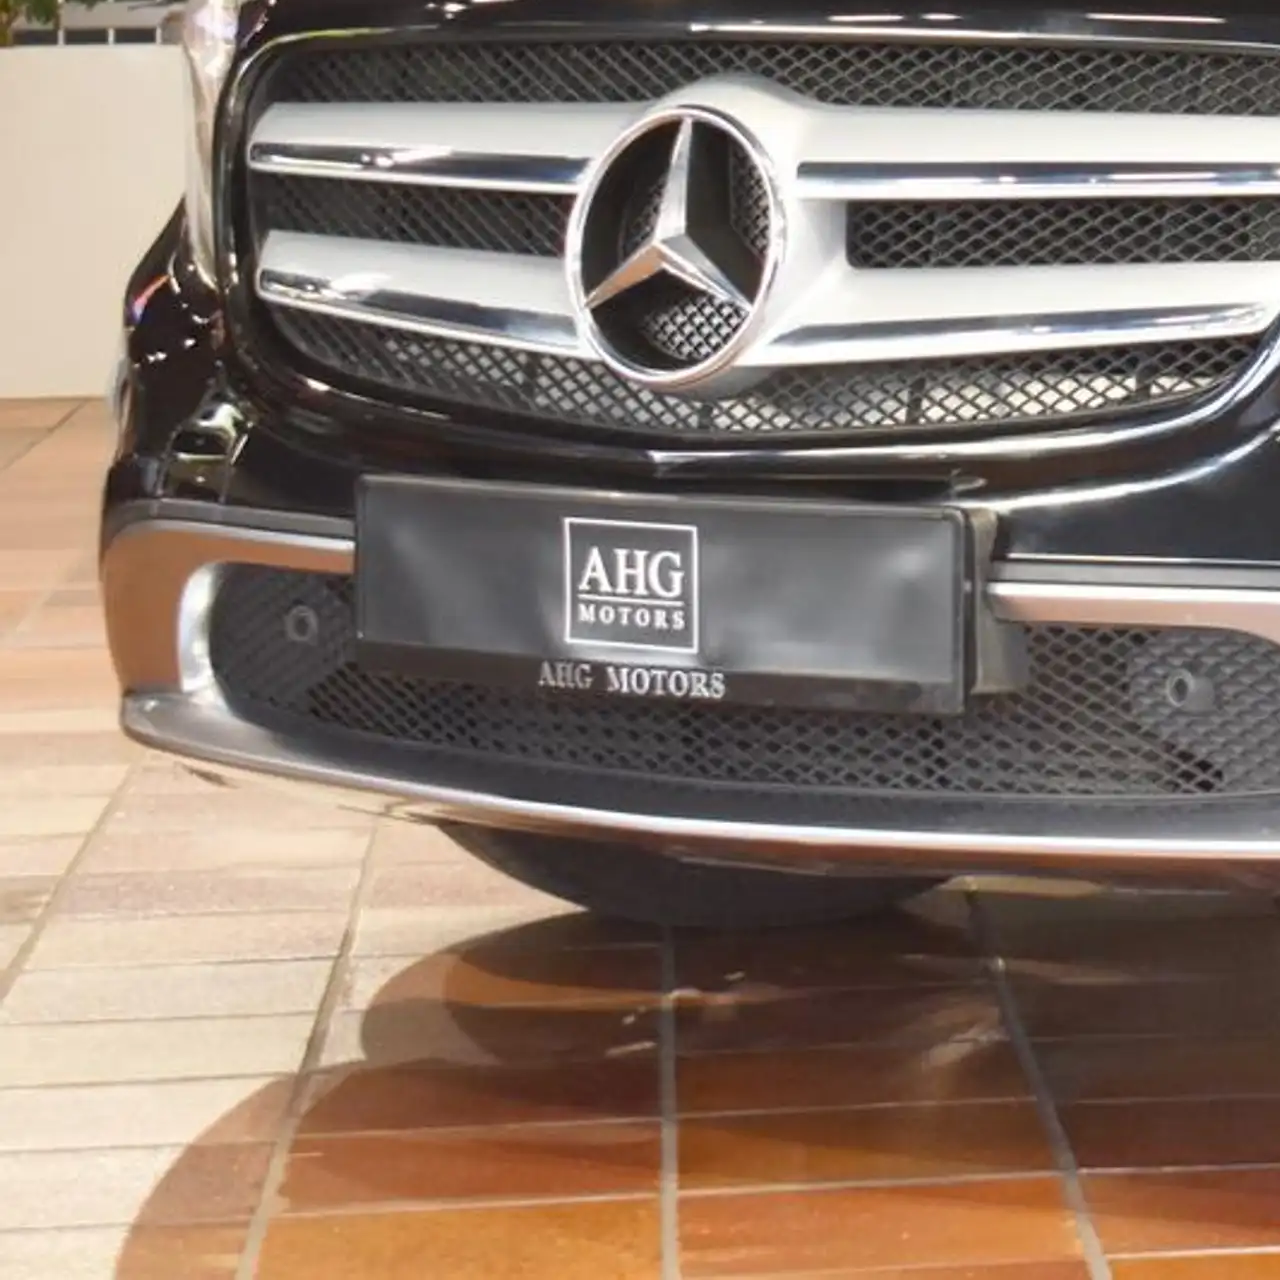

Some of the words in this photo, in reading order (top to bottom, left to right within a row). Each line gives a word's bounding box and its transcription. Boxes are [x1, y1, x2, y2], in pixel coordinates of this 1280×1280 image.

[578, 546, 685, 598] AHG
[578, 603, 685, 630] MOTORS
[538, 660, 593, 689] AHG
[606, 666, 726, 699] MOTORS
